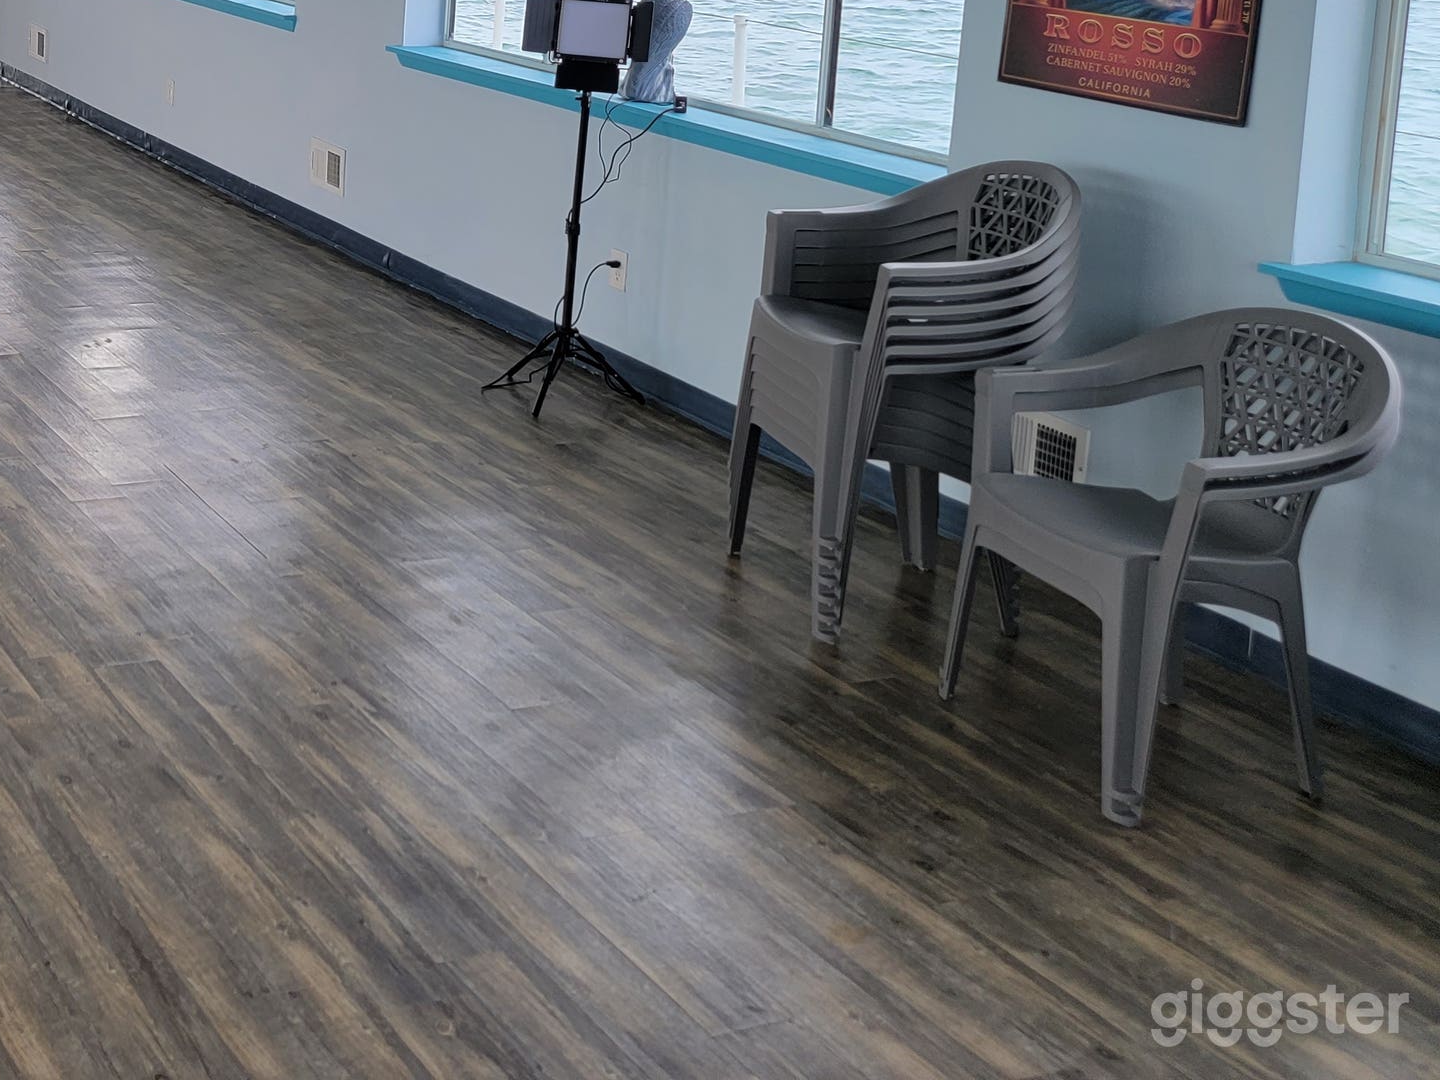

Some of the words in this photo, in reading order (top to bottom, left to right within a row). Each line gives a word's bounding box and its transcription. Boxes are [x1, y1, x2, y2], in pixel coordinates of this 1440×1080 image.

[1043, 13, 1202, 59] ROSSO
[1046, 55, 1102, 73] CABERNET
[1103, 64, 1167, 84] SAUVIGNON
[1169, 76, 1191, 89] 20%
[1047, 42, 1106, 61] ZINFANDEL
[1135, 56, 1173, 72] SYRAH
[1174, 64, 1197, 76] 29%
[1078, 77, 1151, 98] CALIFORNIA
